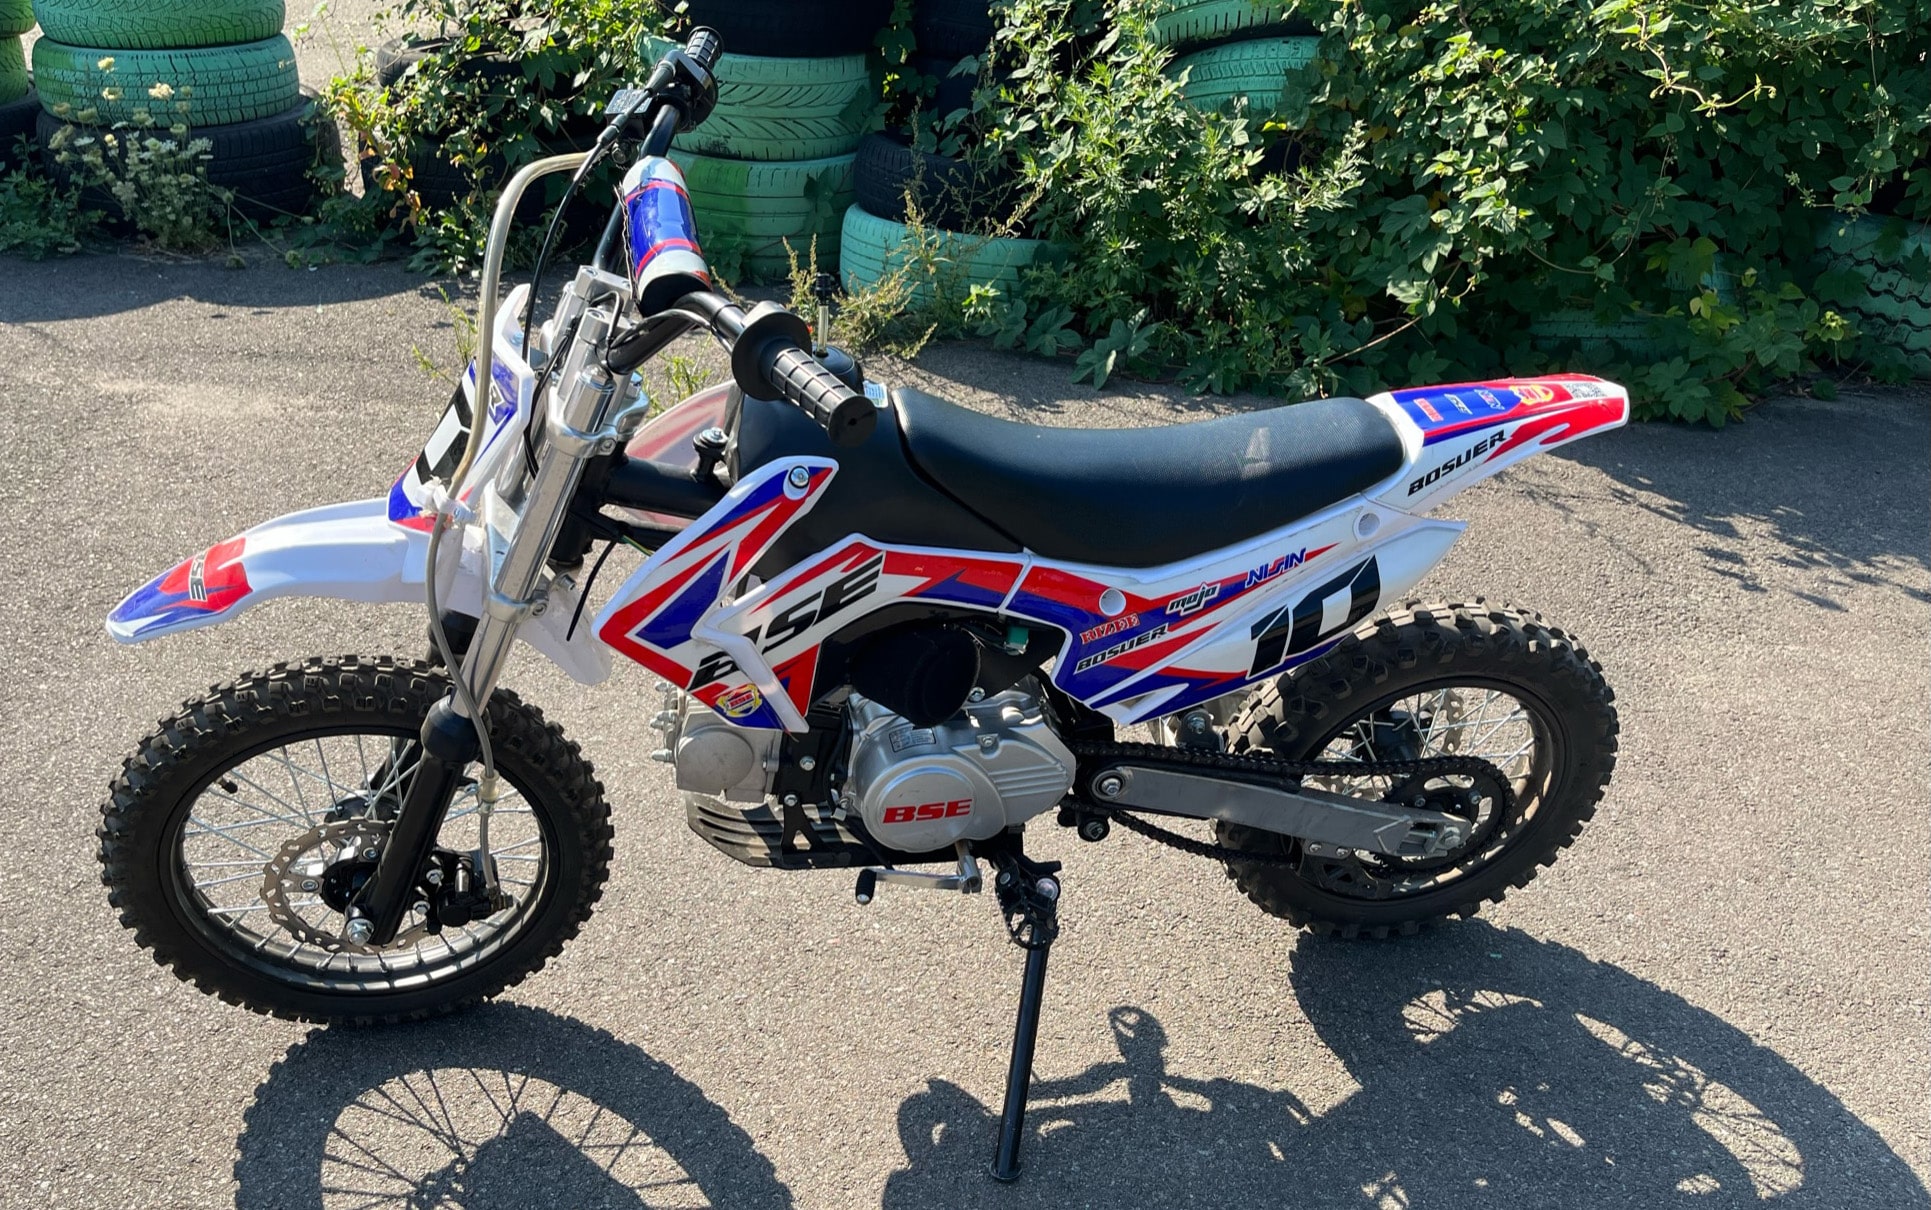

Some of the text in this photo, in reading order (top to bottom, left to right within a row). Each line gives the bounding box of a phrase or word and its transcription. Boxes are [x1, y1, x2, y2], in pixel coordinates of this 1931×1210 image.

[1407, 429, 1507, 497] BOSUER
[1167, 584, 1219, 614] mojo
[1248, 553, 1381, 679] 10
[1074, 624, 1168, 673] BOSUER
[882, 798, 973, 825] BSE
